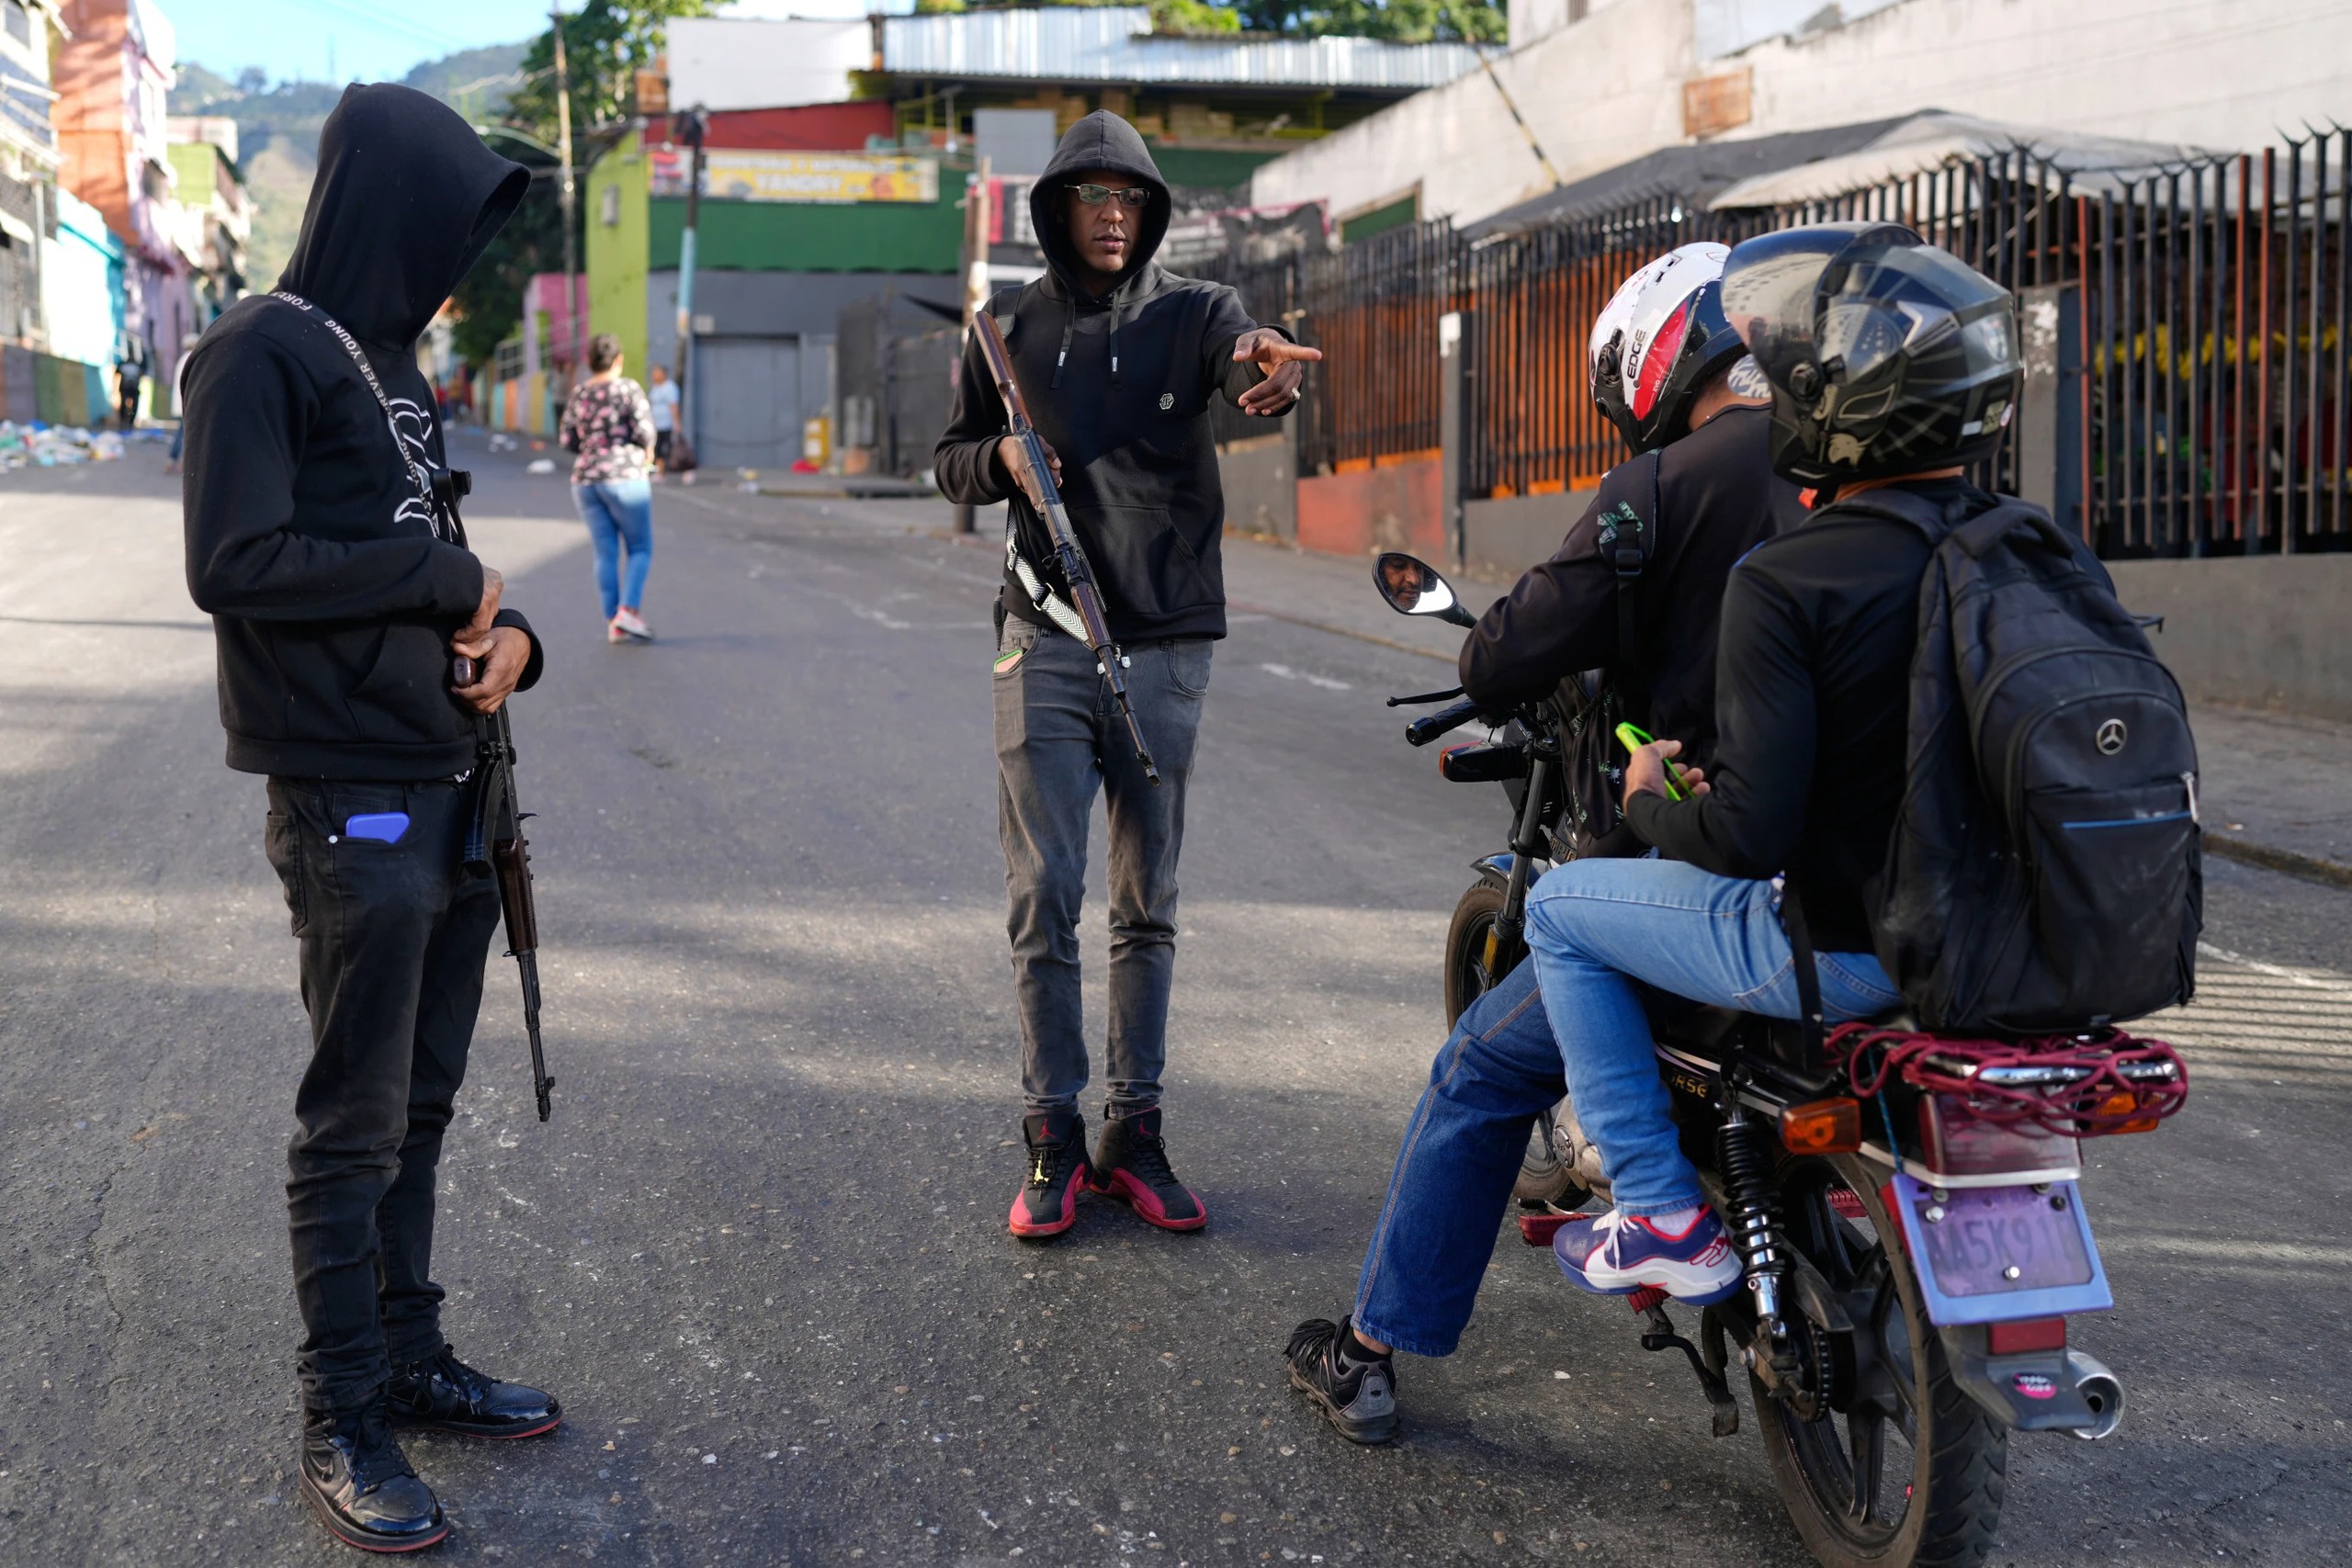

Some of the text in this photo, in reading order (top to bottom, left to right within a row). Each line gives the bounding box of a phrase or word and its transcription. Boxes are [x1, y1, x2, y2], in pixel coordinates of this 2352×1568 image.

[324, 320, 361, 359] YOUNG
[1627, 329, 1646, 378] EDGE
[1653, 379, 1661, 392] EVO
[401, 442, 420, 487] YOUNG
